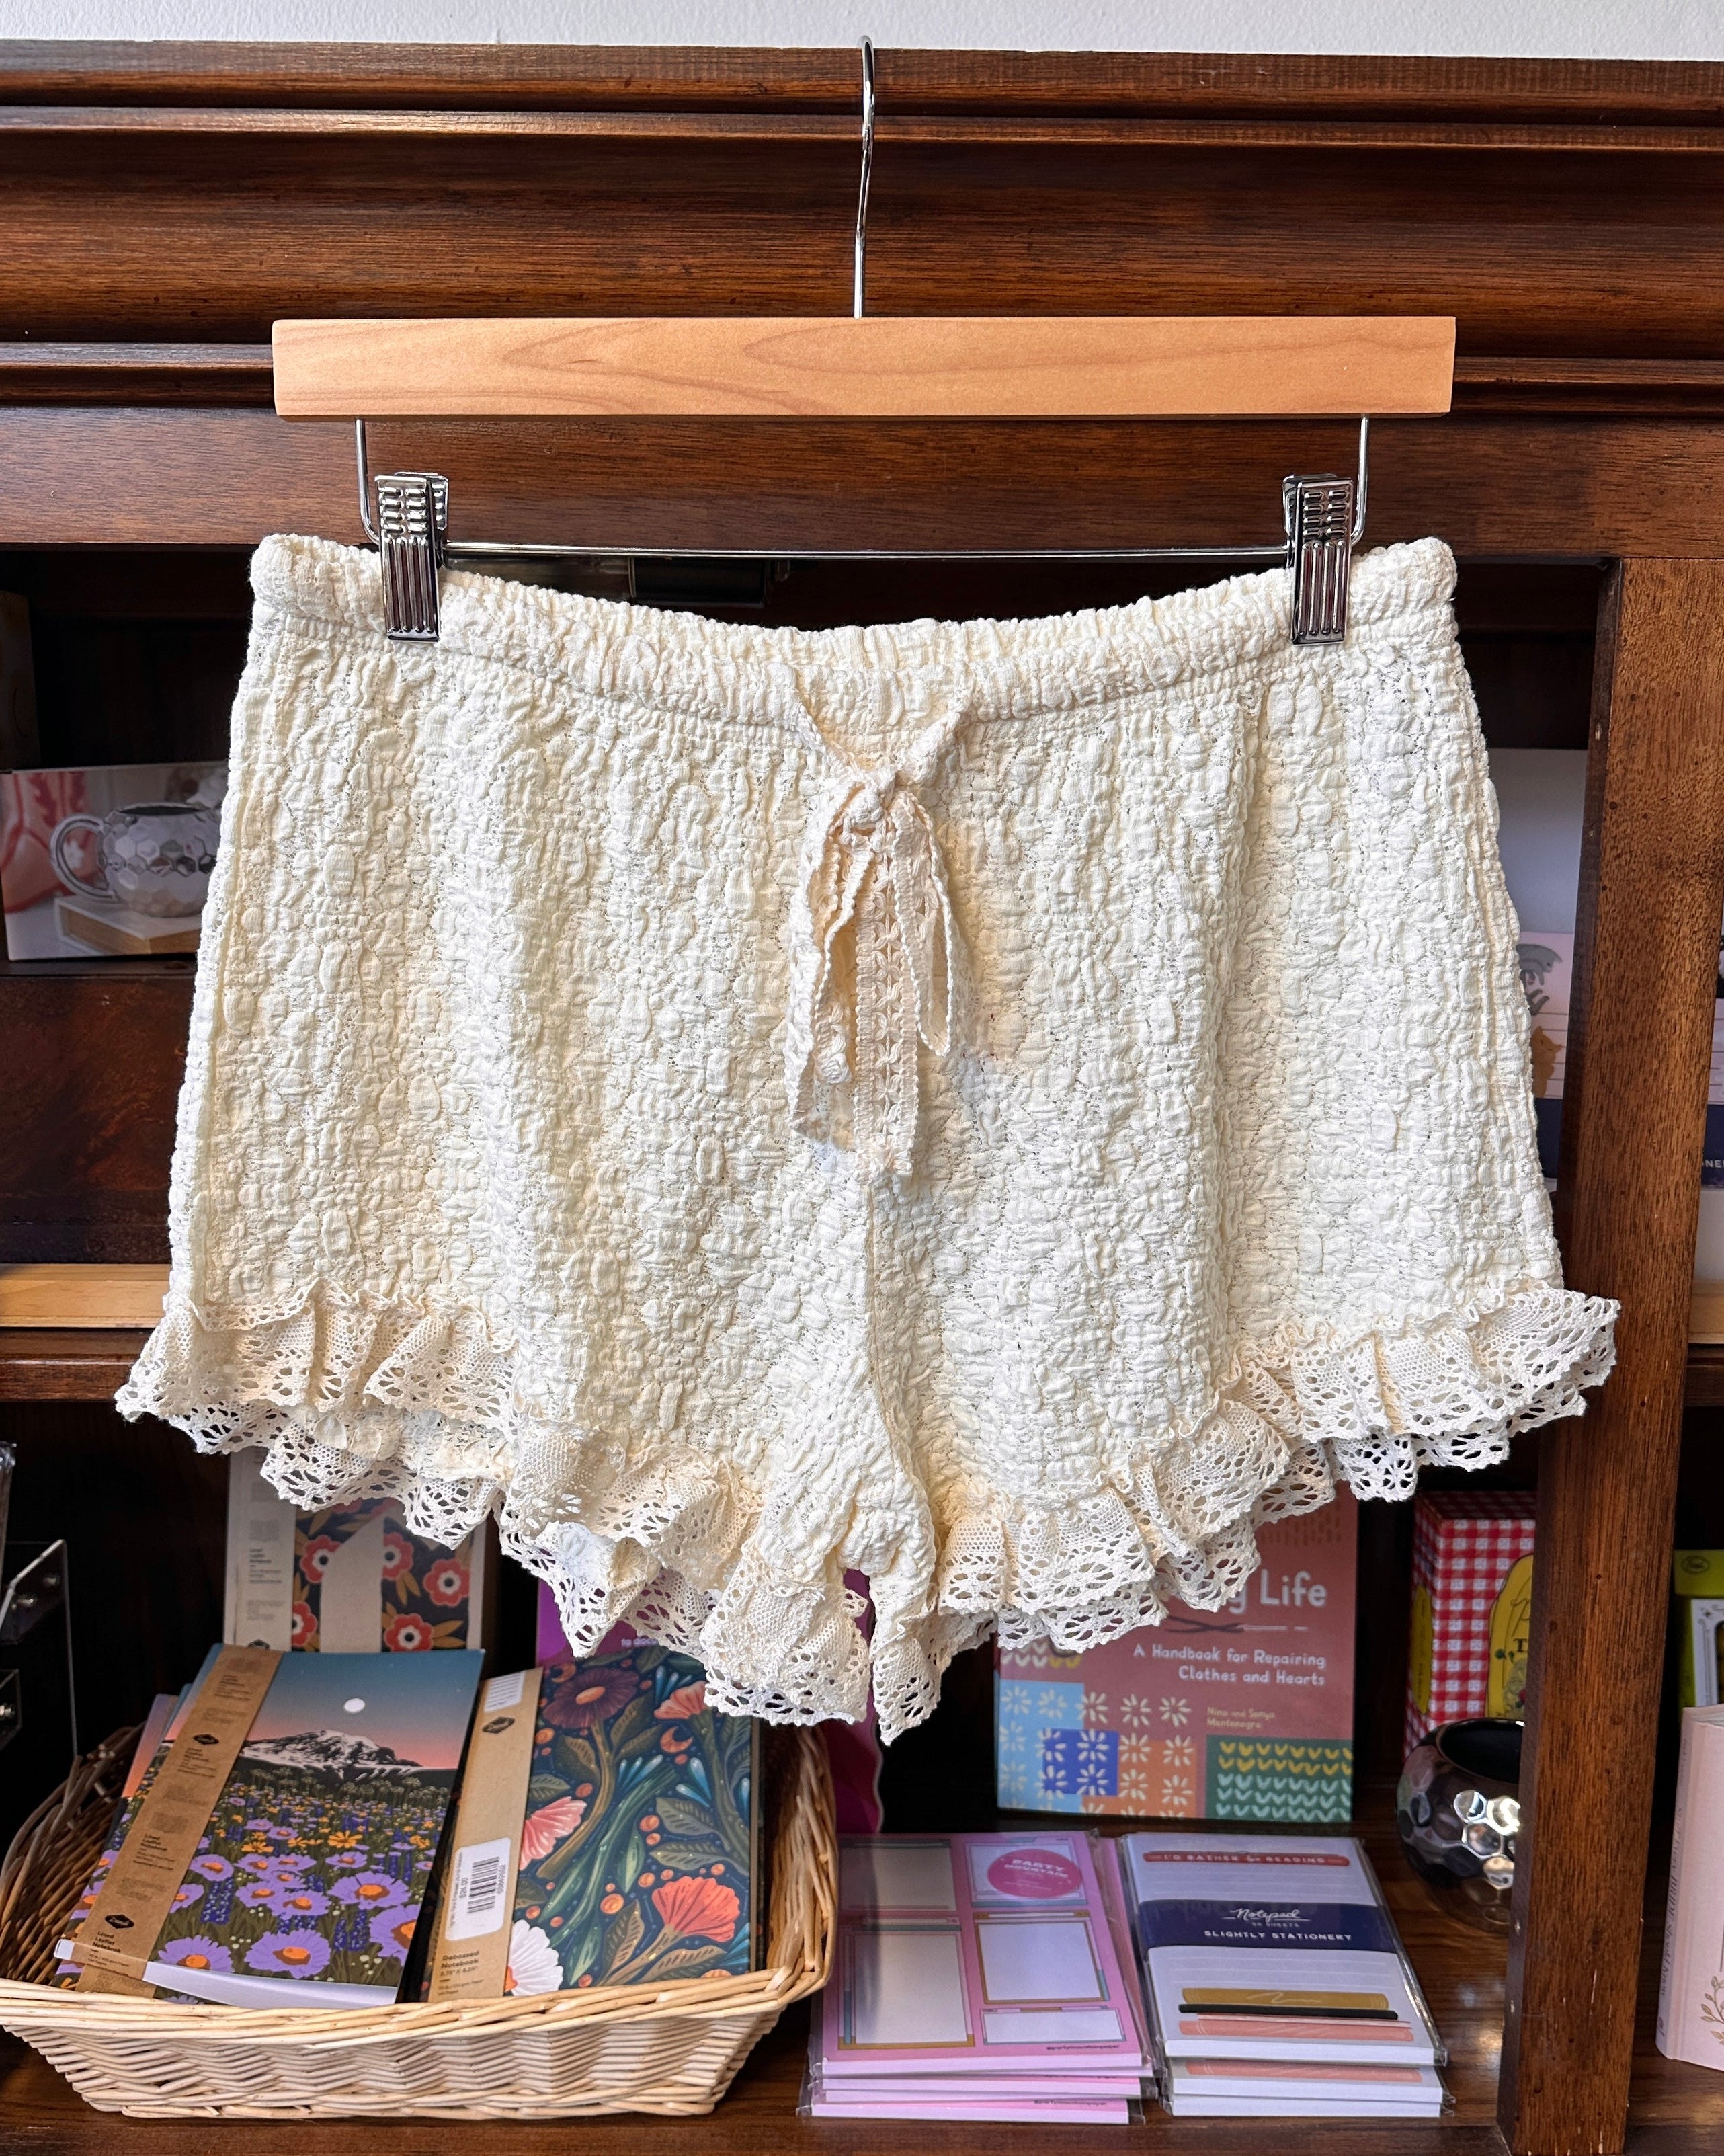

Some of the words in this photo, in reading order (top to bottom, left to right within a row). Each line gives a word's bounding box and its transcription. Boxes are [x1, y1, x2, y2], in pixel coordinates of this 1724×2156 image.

[1260, 1568, 1327, 1607] Life
[1133, 1644, 1145, 1657] A
[1152, 1644, 1221, 1663] Handbook
[1227, 1648, 1249, 1664] for
[1254, 1650, 1327, 1670] Repairing
[1178, 1665, 1237, 1682] Clothes
[1243, 1671, 1270, 1684] and
[1276, 1670, 1326, 1686] Hearts
[1012, 1858, 1065, 1872] PARTY
[1265, 1855, 1325, 1864] READING
[1229, 1908, 1301, 1923] Notepad
[1204, 1930, 1266, 1939] SLIGHTLY
[1271, 1932, 1352, 1942] STATIONERY
[441, 1958, 479, 1968] Notebook
